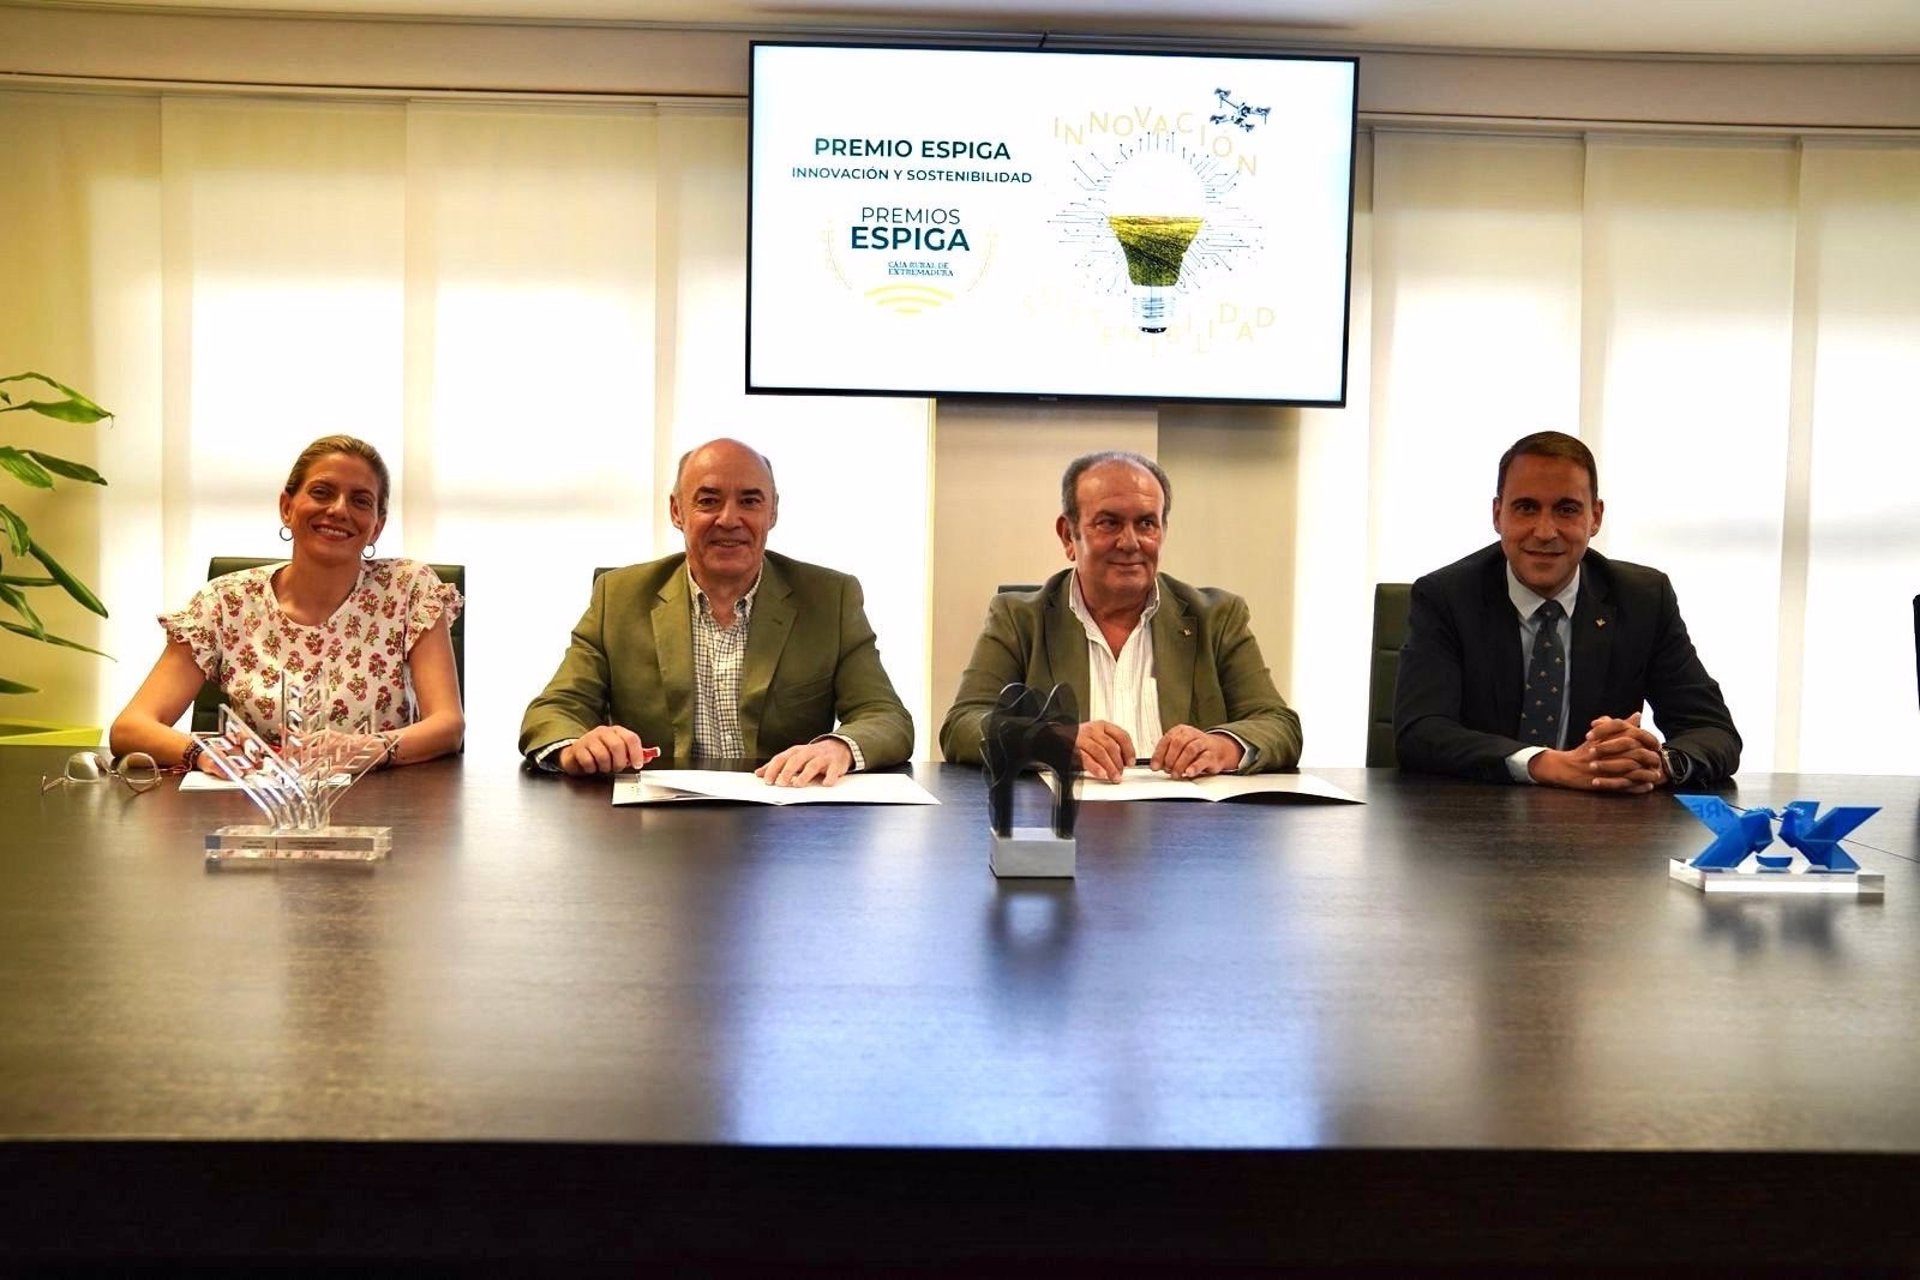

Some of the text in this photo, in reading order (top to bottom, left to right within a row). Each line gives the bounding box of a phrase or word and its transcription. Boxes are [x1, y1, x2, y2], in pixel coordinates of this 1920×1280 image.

[815, 137, 1012, 160] PREMIO ESPIGA
[792, 166, 1033, 184] INNOVACIÓN Y SOSTENIBILIDAD
[861, 206, 961, 225] PREMIOS
[851, 226, 971, 252] ESPIGA
[888, 268, 954, 277] EXTREMADURA
